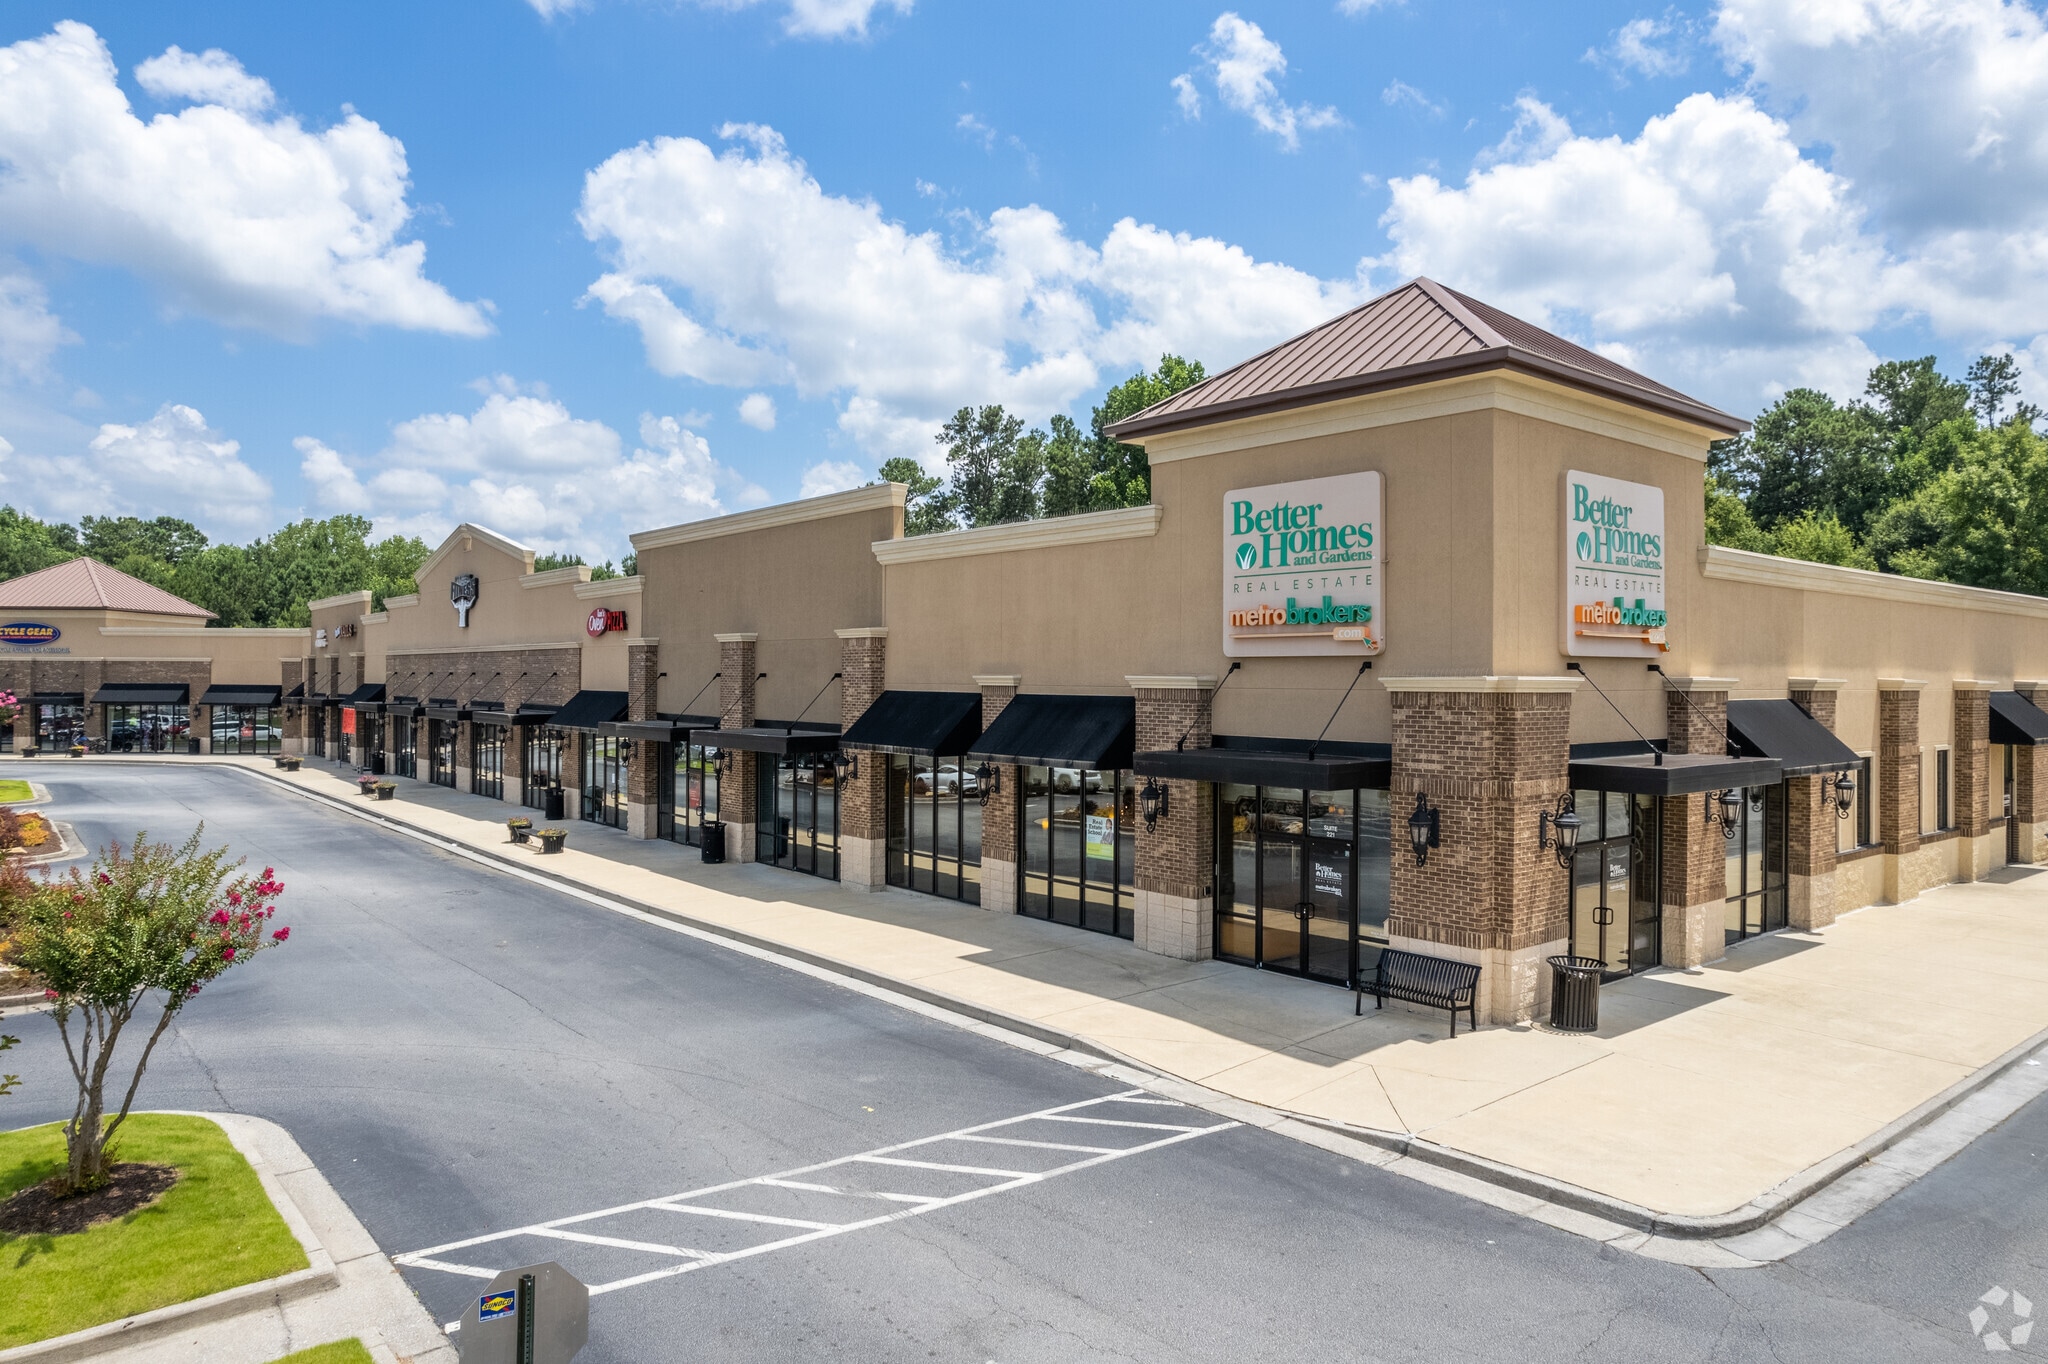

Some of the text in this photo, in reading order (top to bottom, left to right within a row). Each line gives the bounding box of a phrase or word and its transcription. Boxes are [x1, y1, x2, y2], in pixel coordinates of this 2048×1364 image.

[1572, 483, 1632, 529] Better
[1231, 500, 1322, 536] Better
[1259, 522, 1373, 568] Homes
[1593, 525, 1661, 565] Homes
[1293, 550, 1372, 566] and Gardens
[1615, 555, 1661, 569] and Gardens
[1233, 575, 1372, 593] REAL ESTATE
[1575, 575, 1661, 593] REAL ESTATE
[1229, 595, 1372, 626] metrobrokers
[1575, 597, 1667, 627] metrobrokers
[608, 611, 624, 631] PIZZA
[1334, 628, 1362, 638] .com
[484, 1298, 512, 1310] SUNOCO
